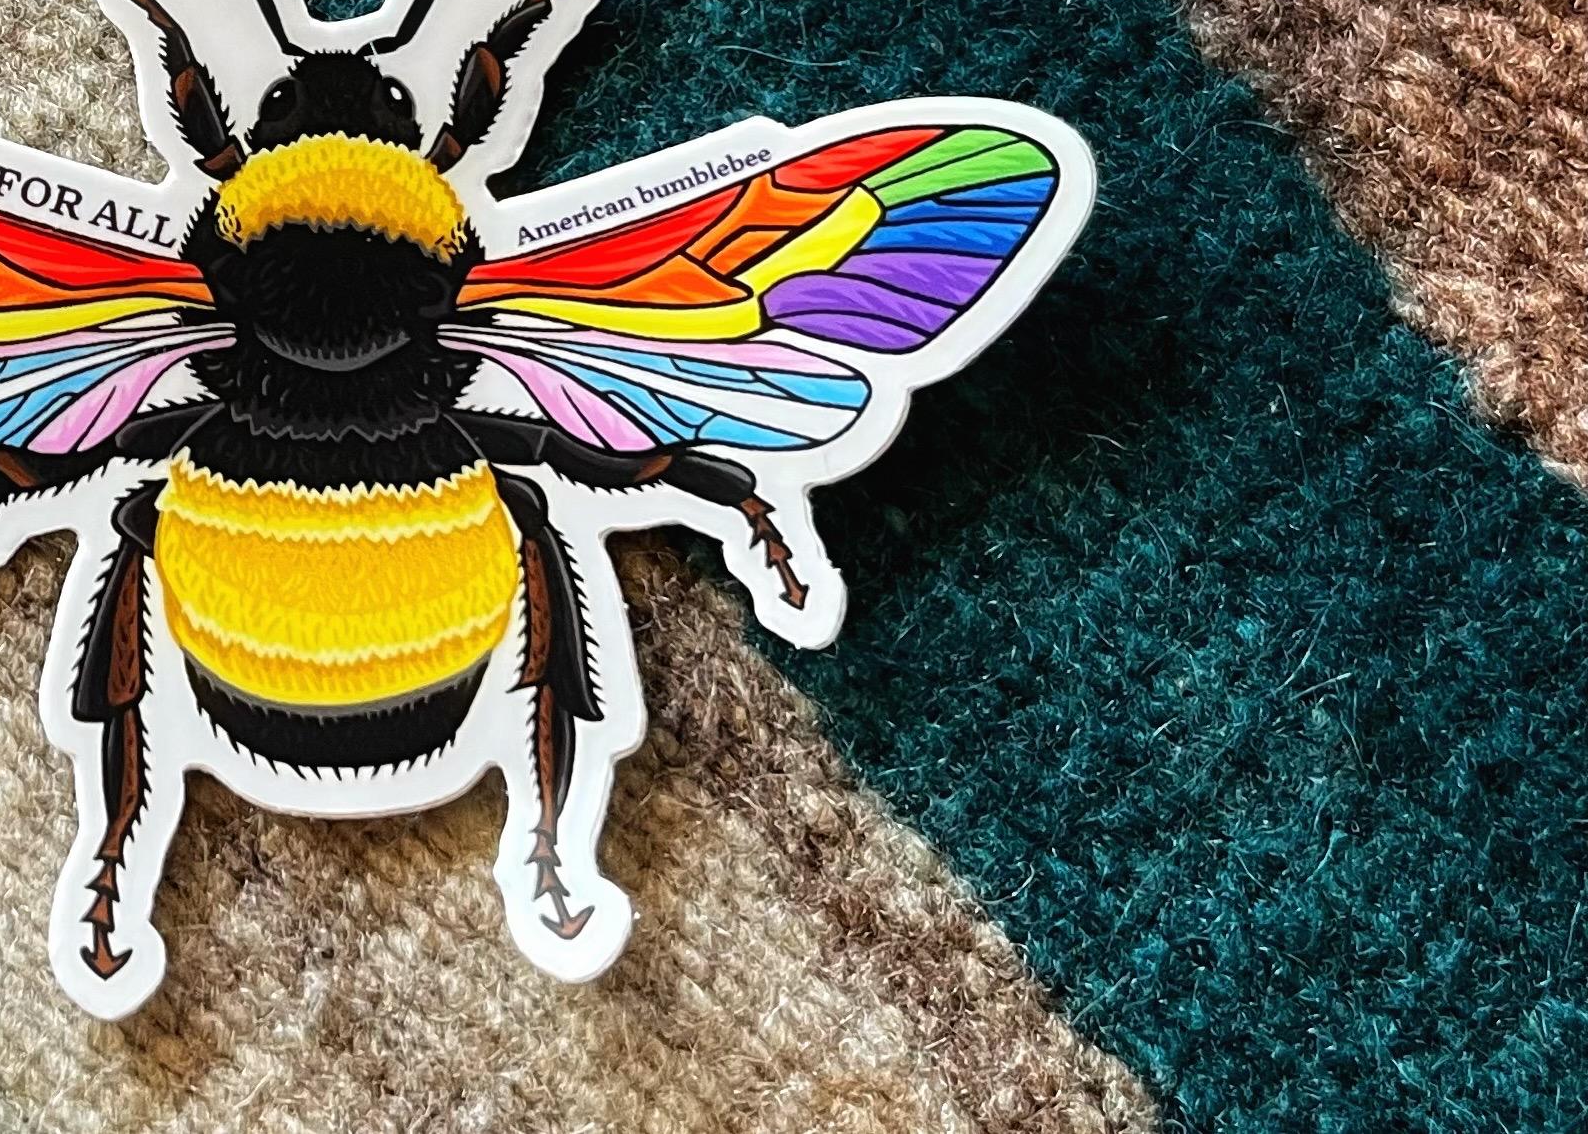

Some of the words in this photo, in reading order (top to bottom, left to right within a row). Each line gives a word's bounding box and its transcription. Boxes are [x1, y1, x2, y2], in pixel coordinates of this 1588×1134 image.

[89, 199, 180, 249] ALL
[517, 194, 637, 247] American
[635, 148, 773, 205] bumblebee
